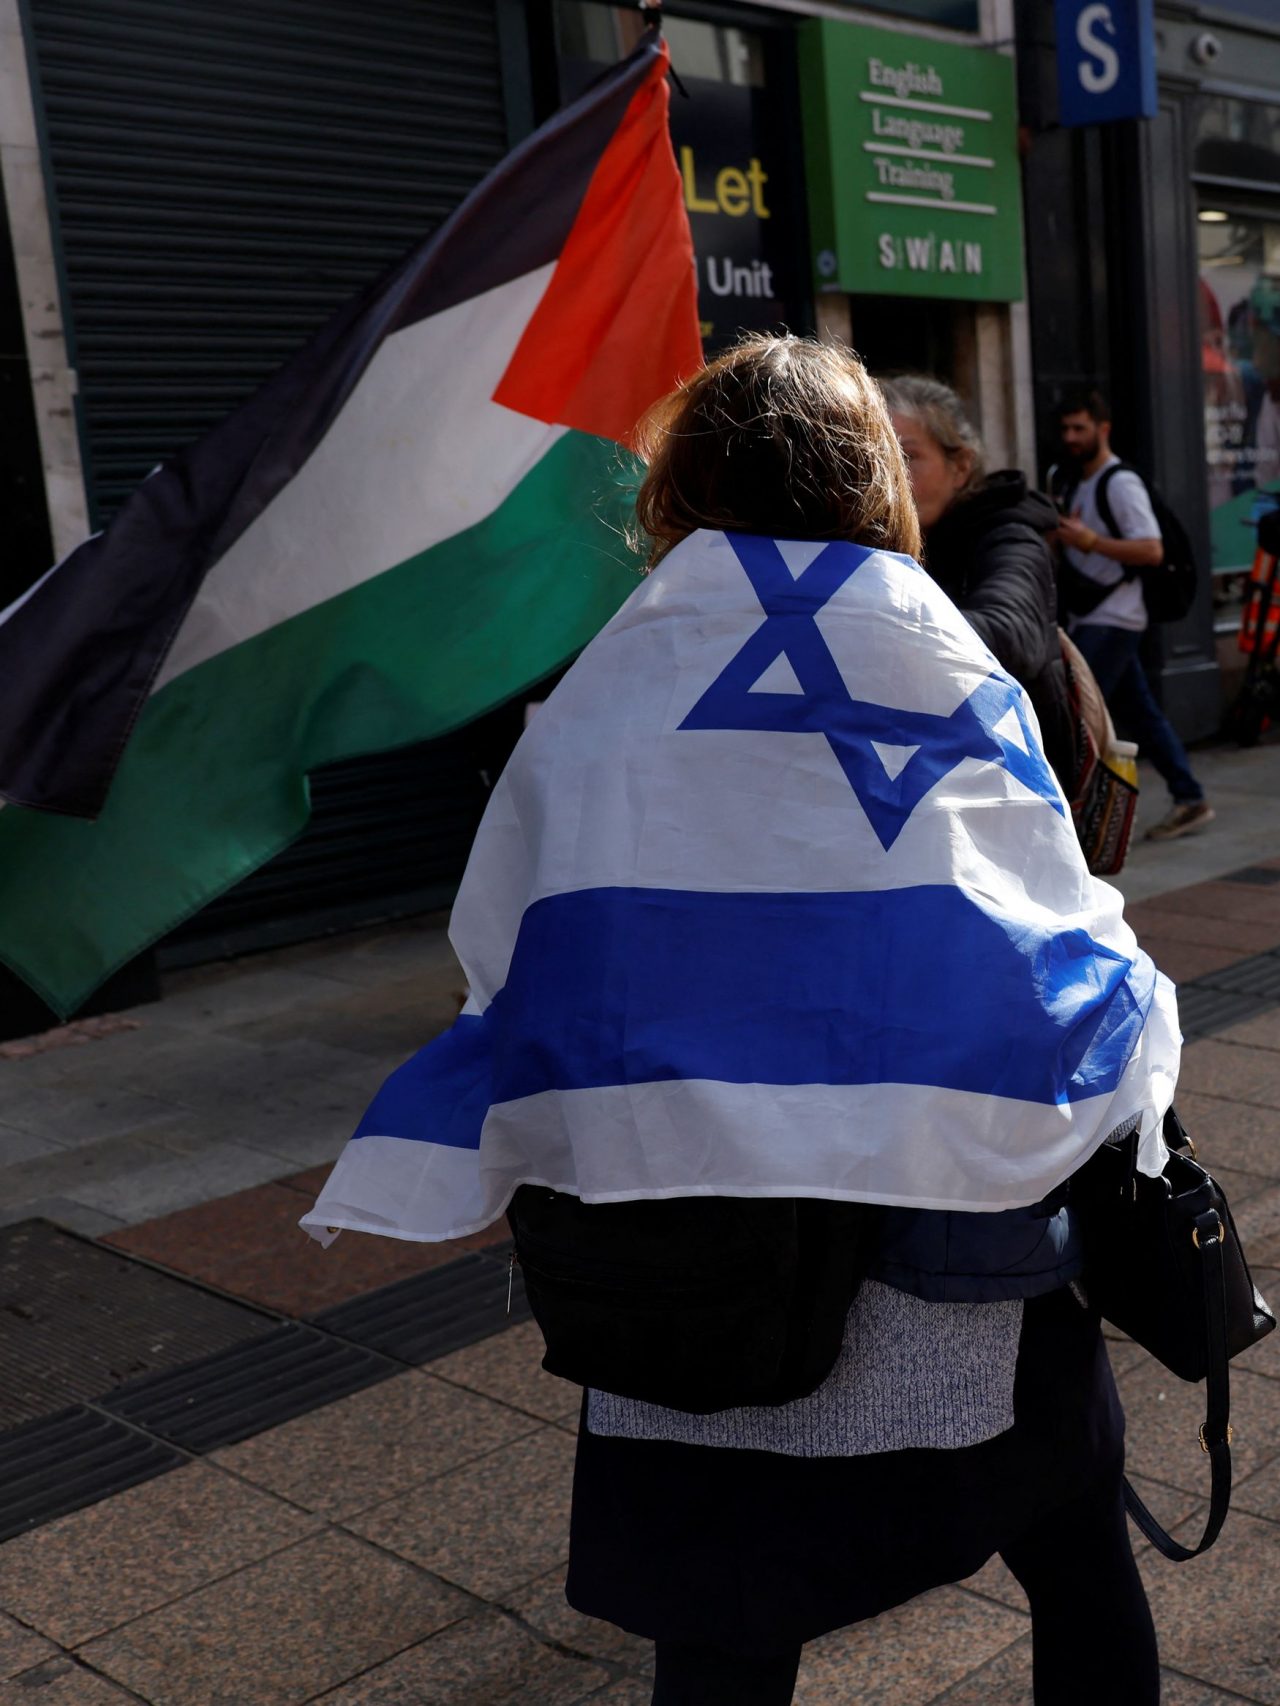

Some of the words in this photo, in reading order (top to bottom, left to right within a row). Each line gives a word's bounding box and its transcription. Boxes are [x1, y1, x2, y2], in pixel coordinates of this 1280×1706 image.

[868, 57, 943, 98] English
[872, 109, 965, 153] Language
[681, 145, 770, 219] Let
[874, 158, 954, 199] Training
[878, 232, 982, 275] SWAN
[707, 257, 774, 298] Unit
